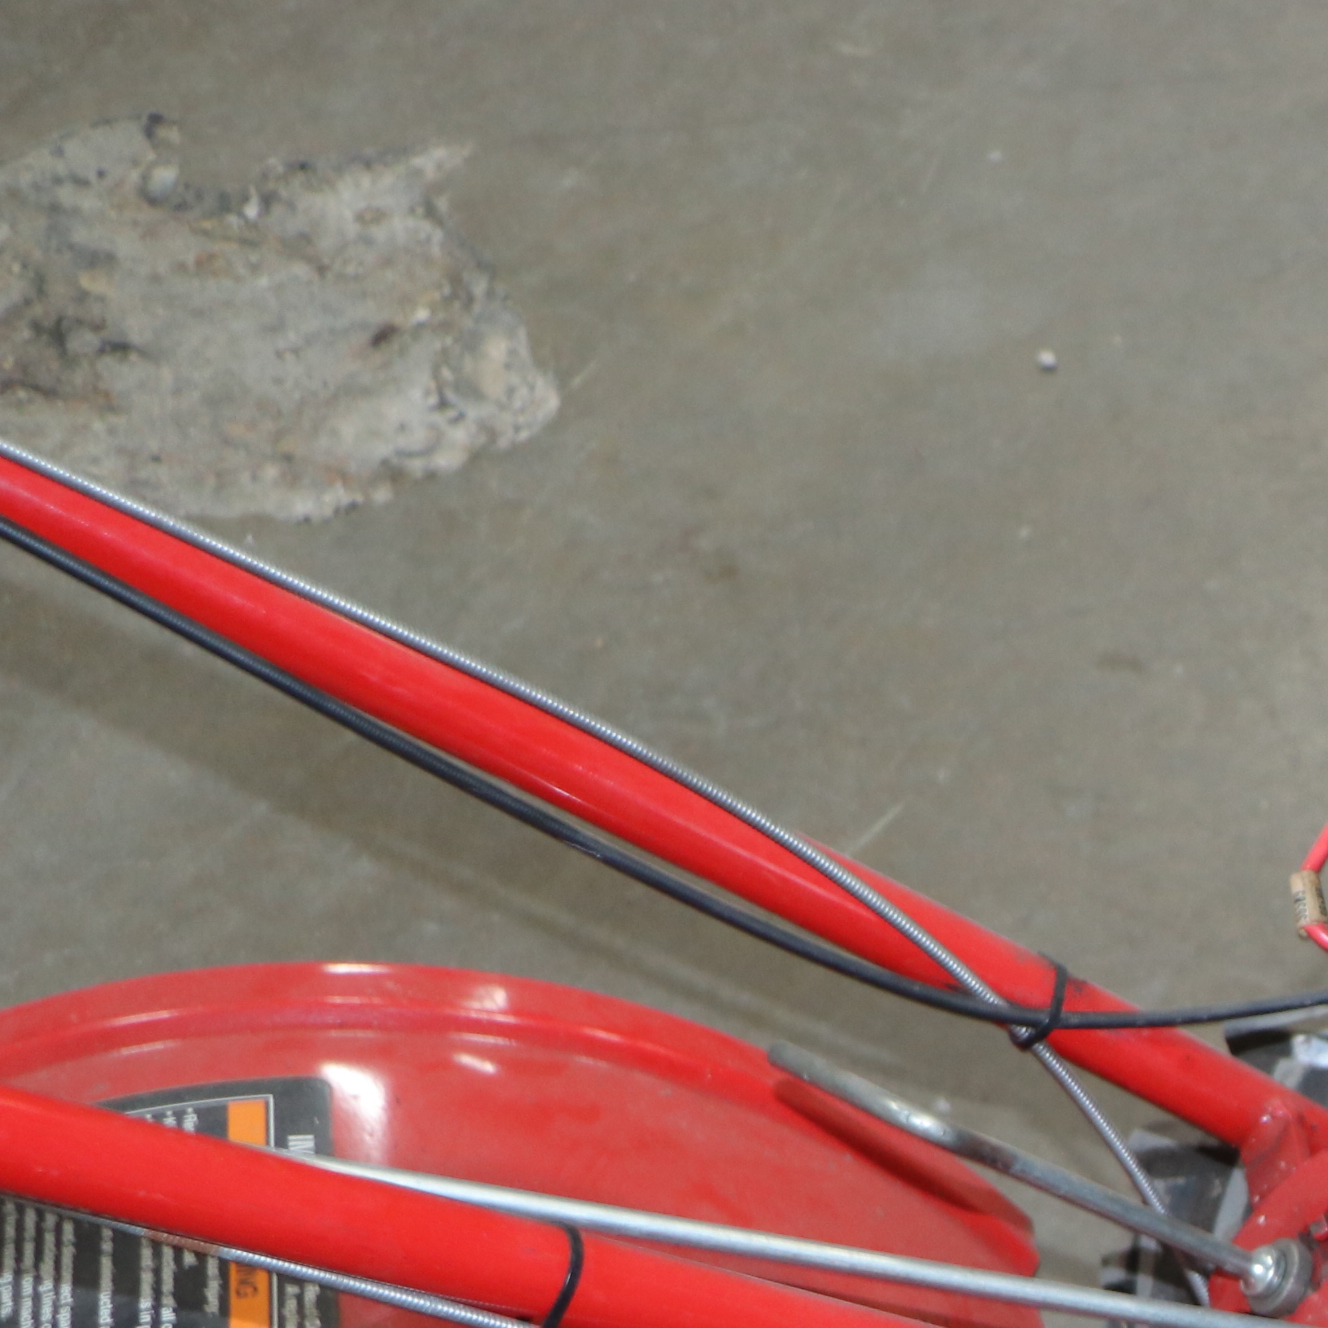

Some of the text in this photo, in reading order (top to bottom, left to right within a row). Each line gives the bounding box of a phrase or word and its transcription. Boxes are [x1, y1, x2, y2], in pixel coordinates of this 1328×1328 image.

[0, 1285, 15, 1318] parts.
[41, 1292, 56, 1320] tines
[140, 1311, 153, 1322] in
[161, 1307, 176, 1321] all
